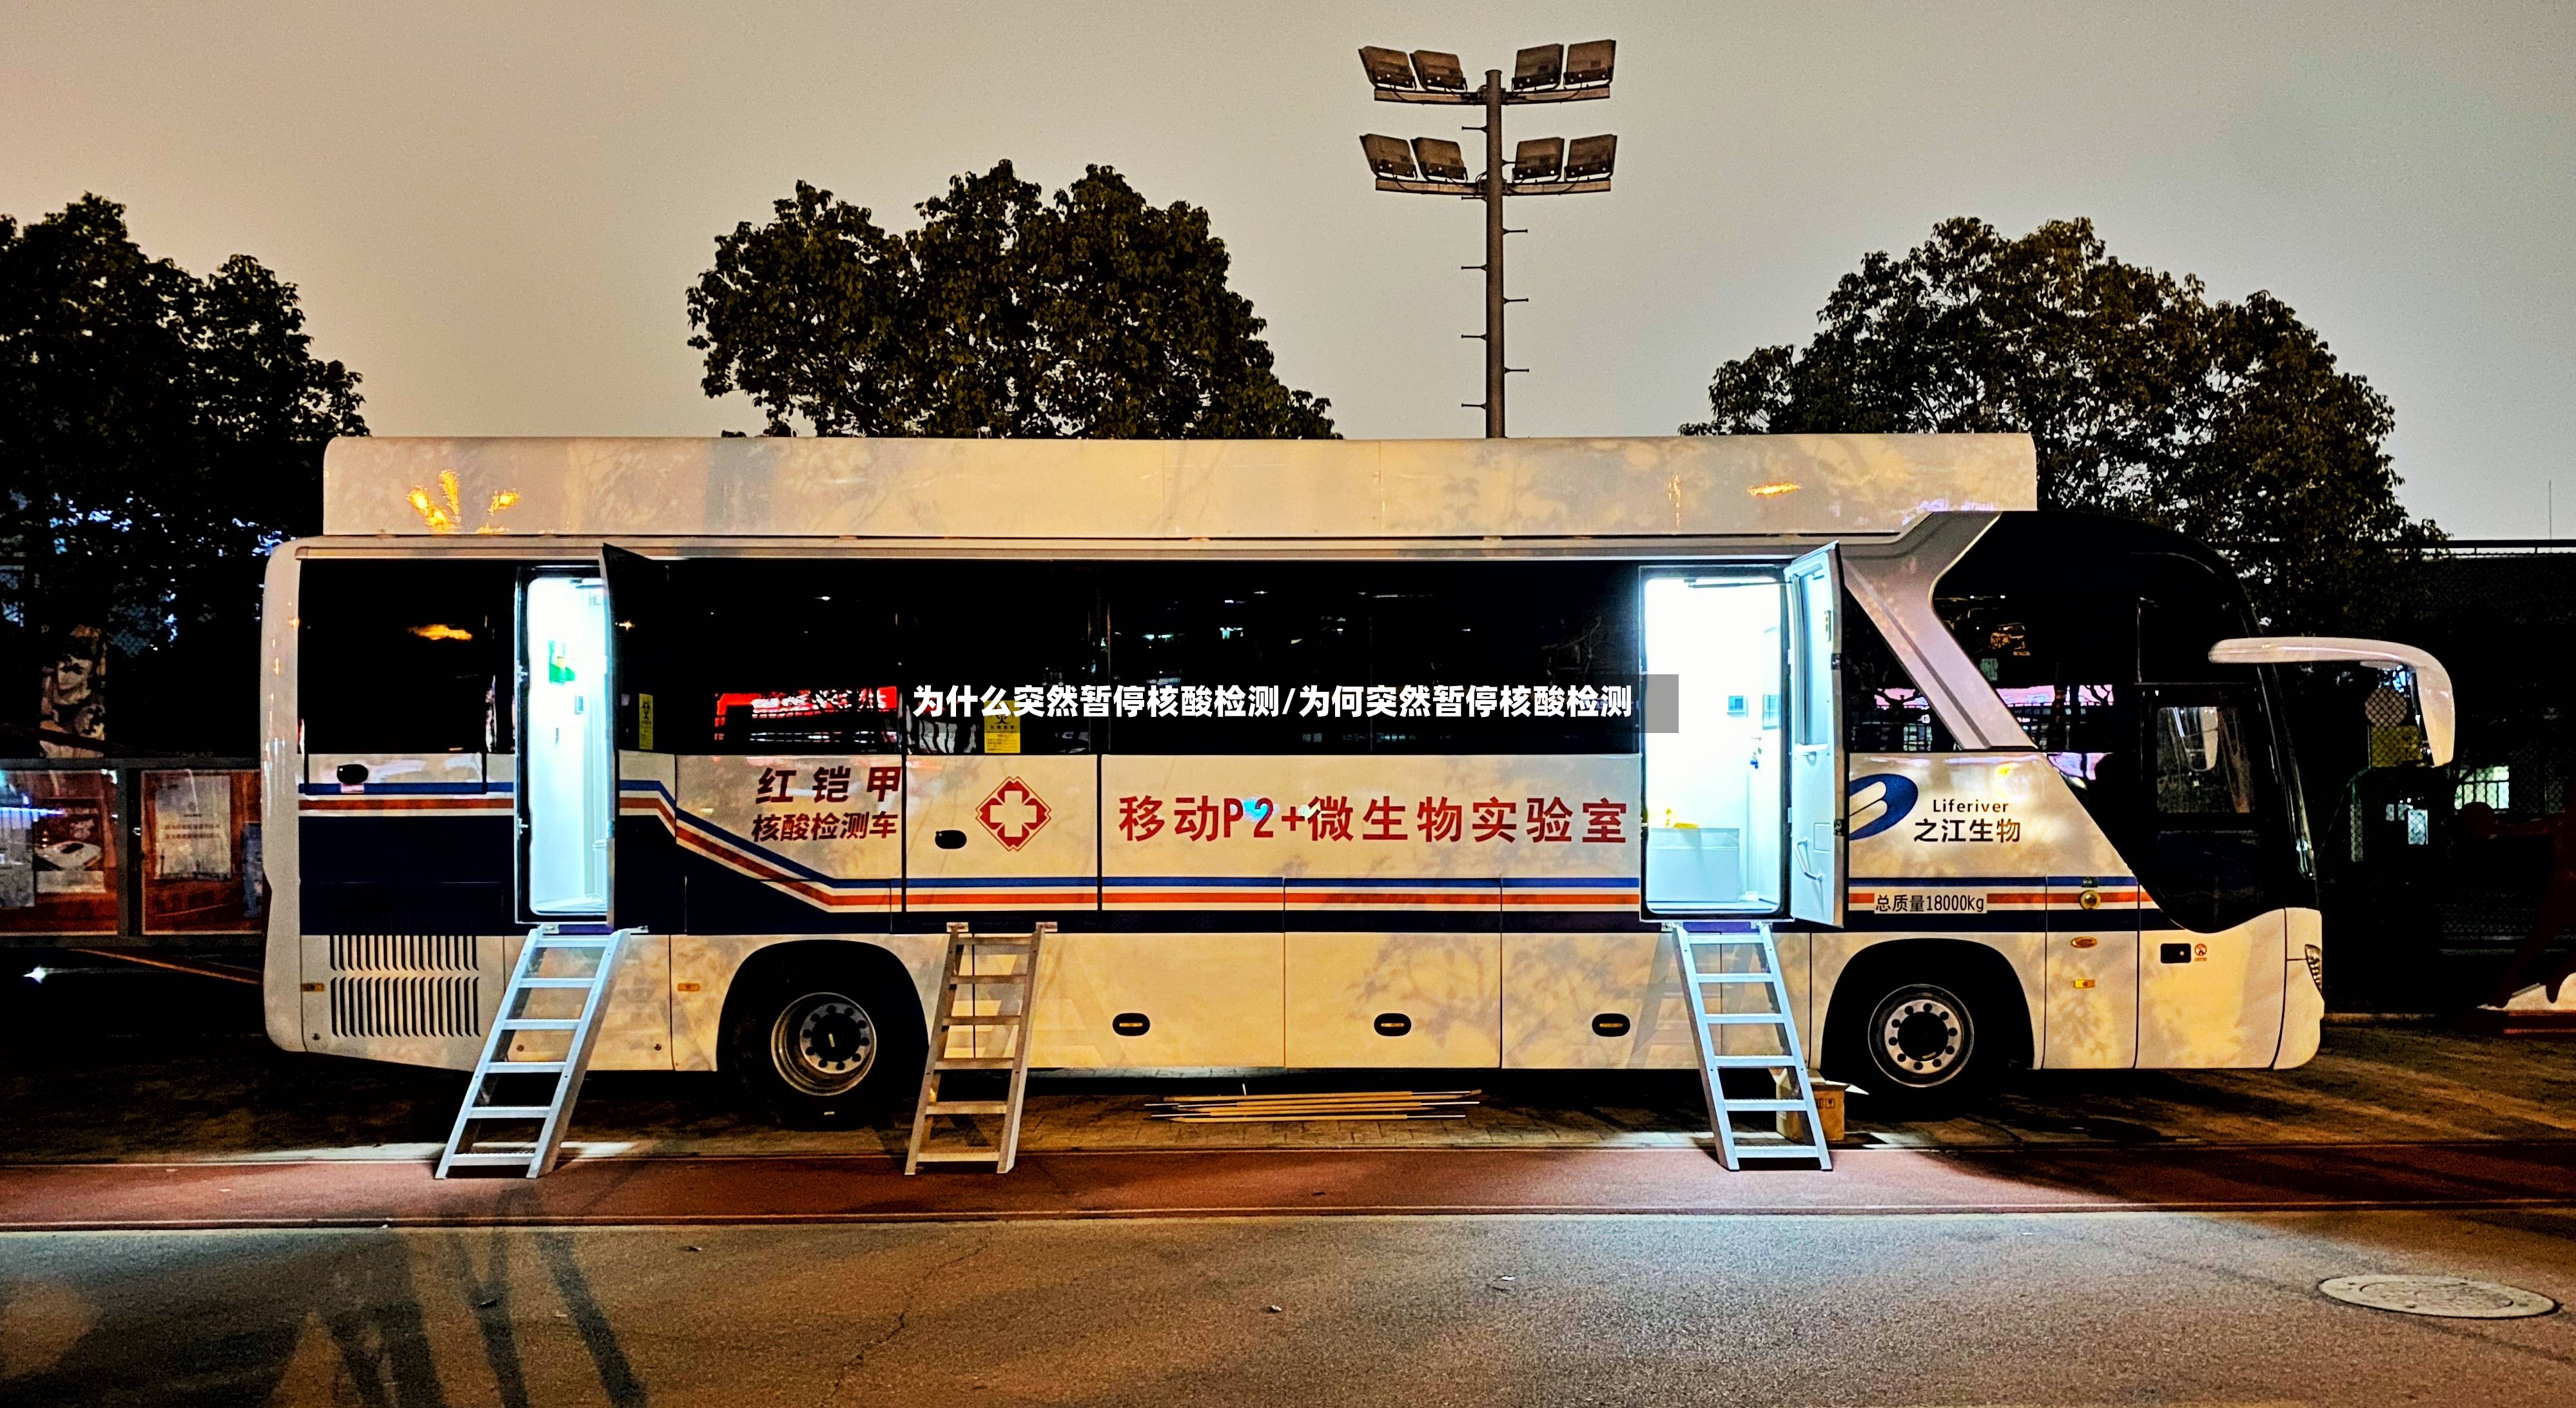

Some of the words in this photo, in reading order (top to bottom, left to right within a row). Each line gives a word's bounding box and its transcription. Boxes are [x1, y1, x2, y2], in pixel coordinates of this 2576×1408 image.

[756, 765, 902, 804] 红铠甲
[1118, 795, 1627, 843] 移动P2+微生物实验室
[1933, 799, 2009, 813] Liferiver
[751, 810, 899, 842] 核酸检测车
[1914, 818, 2021, 843] 之江生物
[1875, 894, 1985, 912] 总质量18000kg
